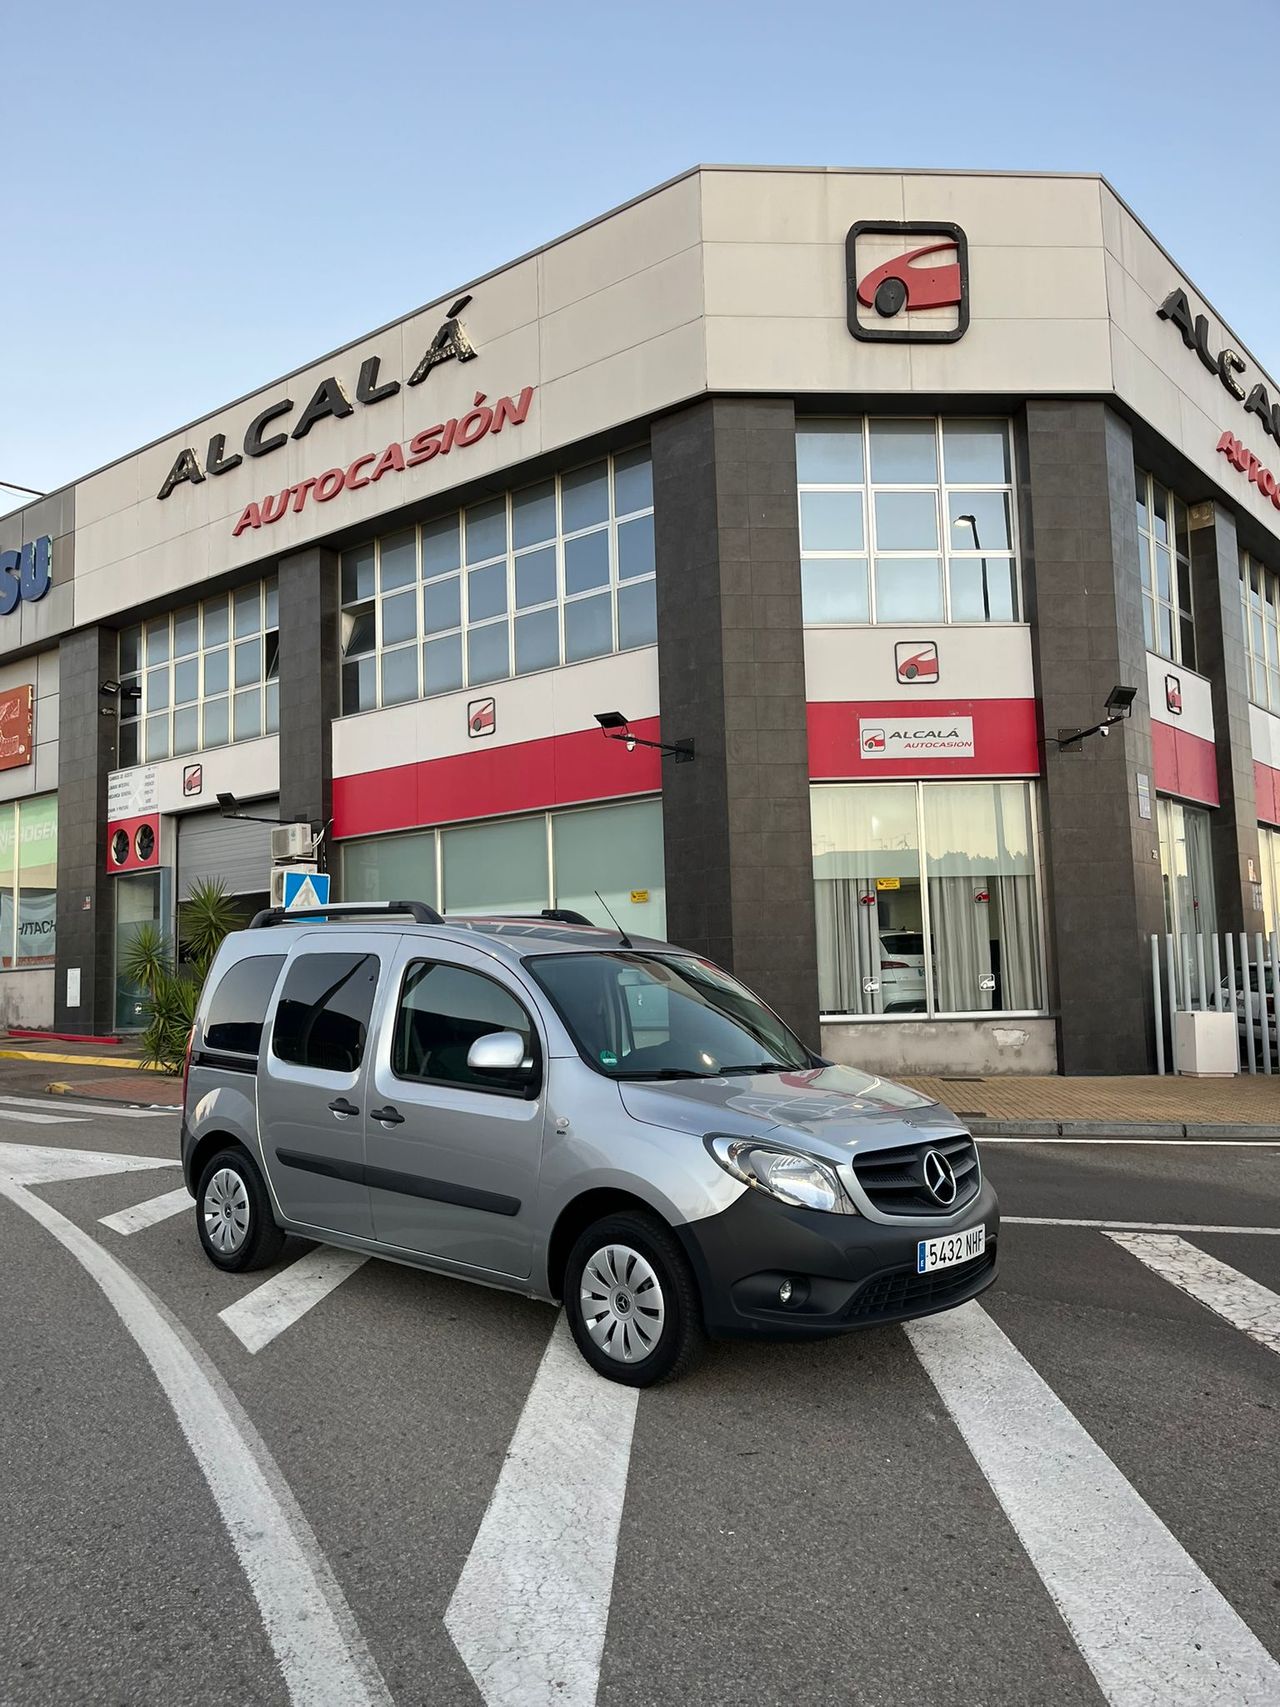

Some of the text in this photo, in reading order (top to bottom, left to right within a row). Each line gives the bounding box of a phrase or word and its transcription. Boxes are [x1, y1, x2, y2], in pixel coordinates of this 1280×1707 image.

[157, 295, 479, 500] ALCALÁ
[231, 385, 535, 537] AUTOCASIÓN
[889, 728, 960, 740] ALCALÁ
[929, 1229, 983, 1266] 5432 NHF
